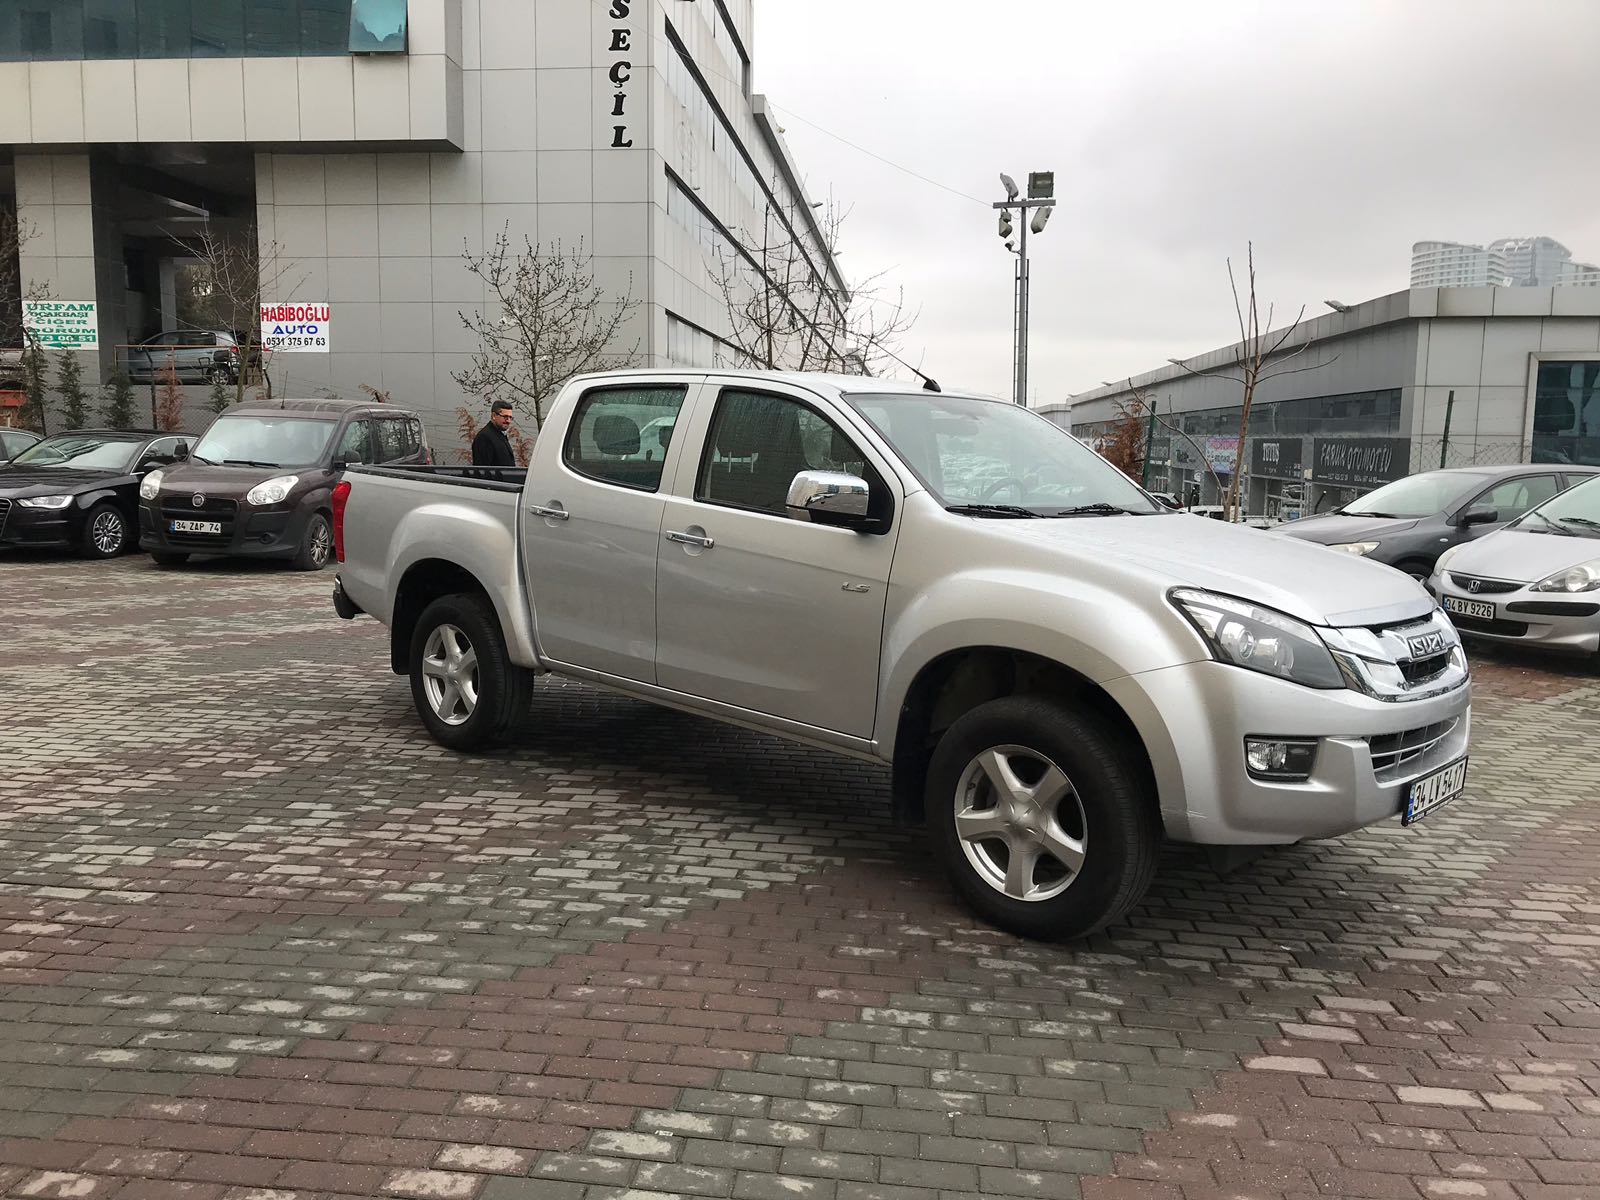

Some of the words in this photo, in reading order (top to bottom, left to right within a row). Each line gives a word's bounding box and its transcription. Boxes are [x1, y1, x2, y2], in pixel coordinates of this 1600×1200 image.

[608, 0, 632, 147] SEÇİL
[261, 303, 330, 322] HABİBOĞLU
[272, 325, 318, 335] AUTO
[266, 337, 285, 346] 0531
[287, 337, 302, 346] 375
[304, 337, 314, 346] 67
[315, 337, 326, 346] 63
[175, 521, 186, 530] 34
[189, 522, 205, 531] ZAP
[209, 523, 220, 532] 74
[1446, 598, 1457, 612] 34
[1457, 601, 1469, 614] BY
[1470, 603, 1492, 618] 9226
[1408, 631, 1447, 657] ISUZU
[1413, 782, 1426, 811] 34
[1428, 774, 1442, 804] LY
